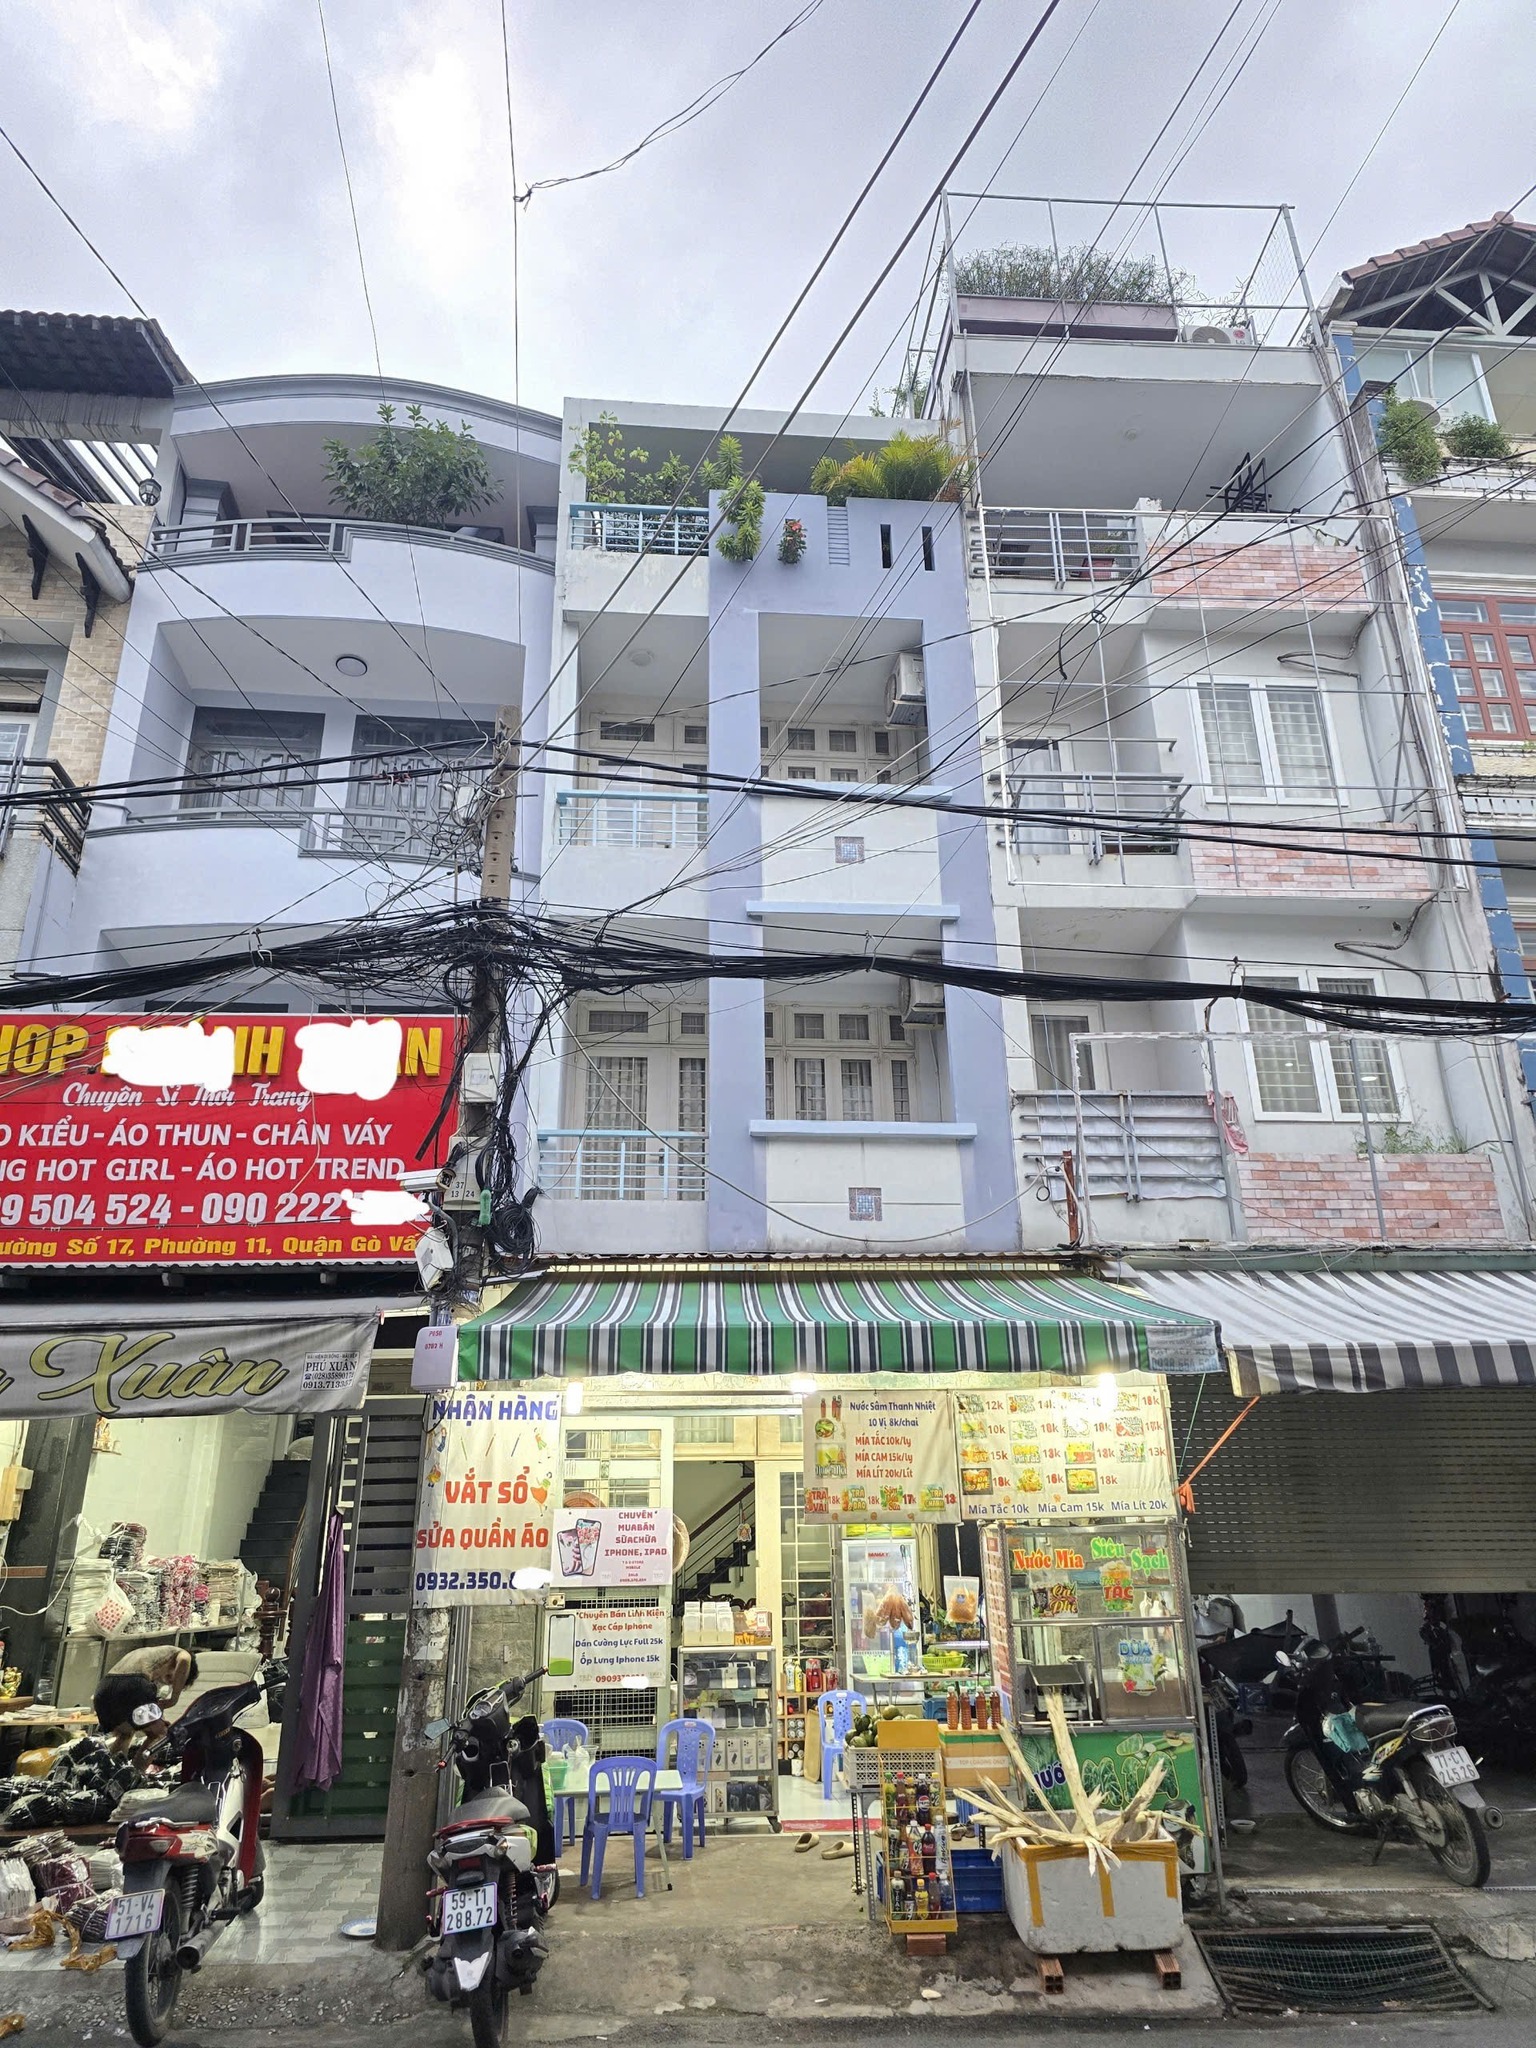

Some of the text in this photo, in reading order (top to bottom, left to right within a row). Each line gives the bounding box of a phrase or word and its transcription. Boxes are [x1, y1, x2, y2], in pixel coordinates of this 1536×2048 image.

[62, 1082, 144, 1112] Chuyên
[249, 1082, 312, 1113] Trang
[18, 1115, 89, 1147] KIỂU
[107, 1118, 149, 1146] ÁO
[155, 1124, 232, 1146] THUN
[252, 1119, 330, 1146] CHÂN
[343, 1118, 392, 1146] VÁY
[36, 1159, 97, 1182] HOT
[106, 1158, 175, 1181] GIRL
[196, 1152, 236, 1181] ÁO
[245, 1158, 303, 1181] HOT
[316, 1158, 404, 1180] TREND
[29, 1194, 95, 1225] 504
[105, 1194, 171, 1225] 524
[201, 1192, 267, 1224] 090
[275, 1192, 342, 1224] 222
[66, 1236, 102, 1255] Số
[107, 1238, 135, 1256] 17,
[144, 1237, 236, 1256] Phường
[245, 1238, 272, 1255] 11,
[283, 1237, 342, 1257] Quận
[351, 1235, 381, 1252] Gò
[306, 1359, 357, 1371] PHÚ XUÂN
[29, 1332, 290, 1413] Xuân
[432, 1394, 558, 1426] NHẬN HÀNG
[850, 1401, 936, 1413] Nước Sâm Thanh Nhiệt
[986, 1401, 1004, 1410] 12k
[869, 1418, 919, 1430] 10 Vị 8k/chai
[855, 1433, 871, 1445] MÍA
[886, 1436, 912, 1447] 10k/ly
[855, 1450, 913, 1464] MÍA CAM 15k/ly
[991, 1451, 1008, 1460] 15k
[856, 1466, 872, 1478] MÍA
[872, 1466, 885, 1478] LÍT
[885, 1467, 913, 1478] 20k/Lít
[445, 1466, 529, 1504] VẮT SỔ
[968, 1503, 1029, 1514] Mía Tắc 10k
[1038, 1502, 1104, 1513] Mía Cam 15k
[1111, 1500, 1168, 1511] Mía Lít 20k
[618, 1510, 653, 1519] CHUYÊN
[416, 1517, 549, 1550] SỬA QUẦN ÁO
[604, 1548, 667, 1557] IPHONE, IPAD
[1090, 1536, 1126, 1559] Siêu
[1013, 1548, 1084, 1570] Nước Mía
[1130, 1547, 1169, 1577] Sạch
[578, 1610, 608, 1621] Chuyên
[610, 1608, 626, 1618] Bán
[646, 1608, 665, 1619] Kiện
[592, 1622, 653, 1633] Xạc Cáp Iphone
[575, 1639, 591, 1647] Dán
[620, 1639, 632, 1648] Lực
[634, 1638, 649, 1646] Full
[580, 1652, 592, 1665] Ốp
[594, 1657, 614, 1665] Lưng
[616, 1655, 645, 1664] Iphone
[117, 1894, 155, 1916] 51-V4
[451, 1888, 487, 1911] 59-T1
[115, 1913, 152, 1935] 1716
[446, 1906, 493, 1931] 288.72
